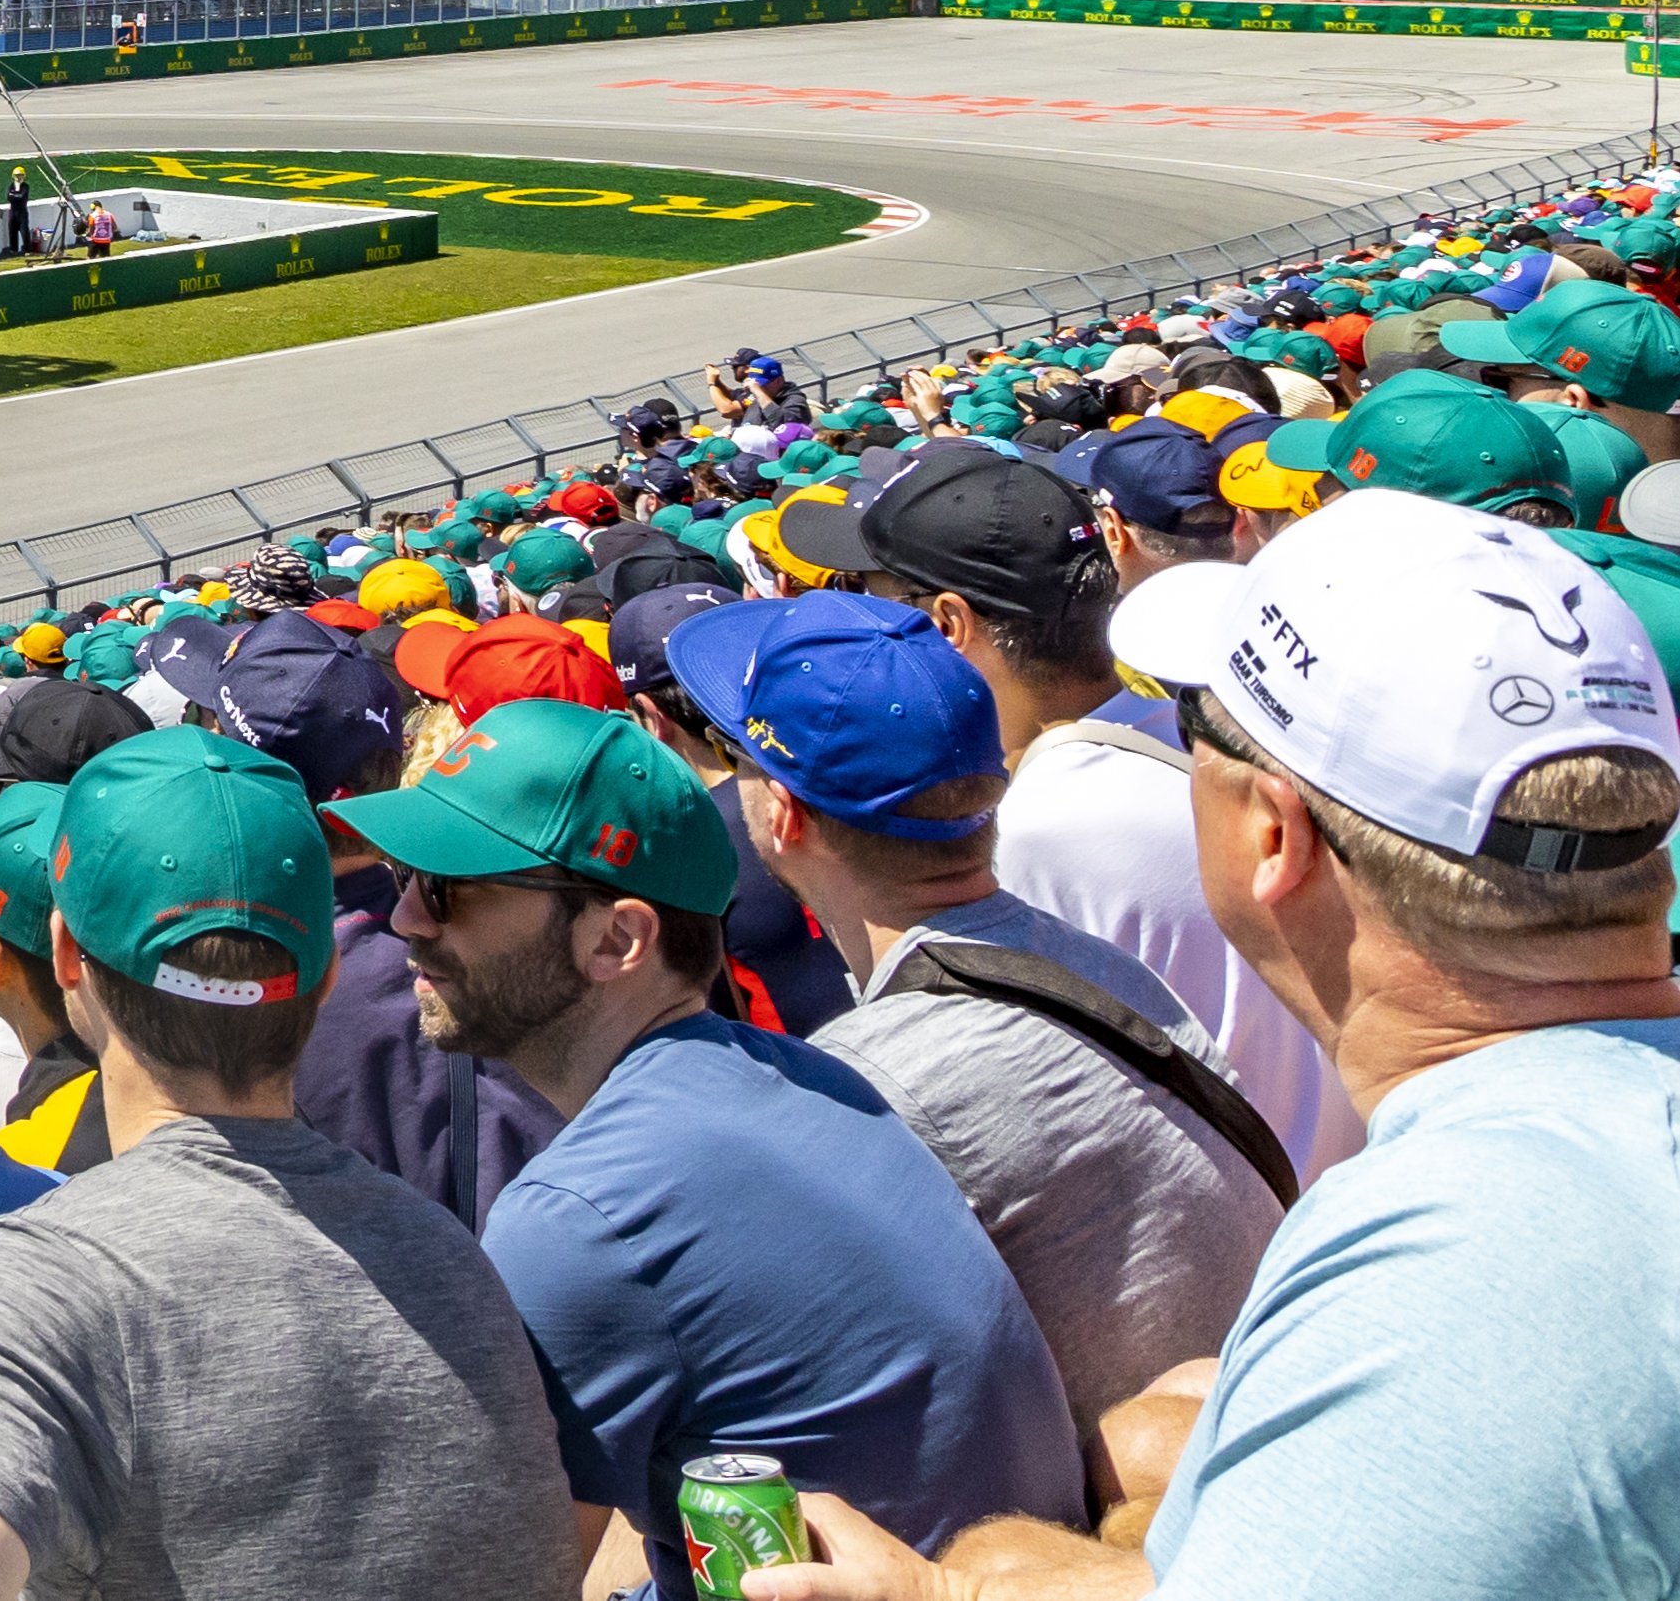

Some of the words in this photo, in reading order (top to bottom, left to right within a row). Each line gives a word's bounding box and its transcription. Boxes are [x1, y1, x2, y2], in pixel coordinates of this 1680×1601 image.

[941, 7, 982, 16] ROLEX
[1011, 10, 1055, 20] ROLEX
[1085, 13, 1131, 23] ROLEX
[1162, 17, 1208, 27] ROLEX
[1242, 20, 1290, 29] ROLEX
[1325, 22, 1375, 31] ROLEX
[1410, 25, 1461, 33] ROLEX
[1498, 27, 1551, 37] ROLEX
[366, 245, 401, 262] ROLEX
[276, 258, 314, 277] ROLEX
[179, 273, 220, 293] ROLEX
[73, 290, 116, 310] ROLEX
[1557, 346, 1590, 373] 18
[1348, 448, 1378, 480] 18
[1273, 620, 1319, 681] FTX
[1231, 650, 1253, 680] GRAN
[1249, 676, 1294, 726] TURISMO
[220, 685, 261, 747] CarNext
[590, 822, 639, 868] 18
[688, 1482, 783, 1568] ORIGINA
